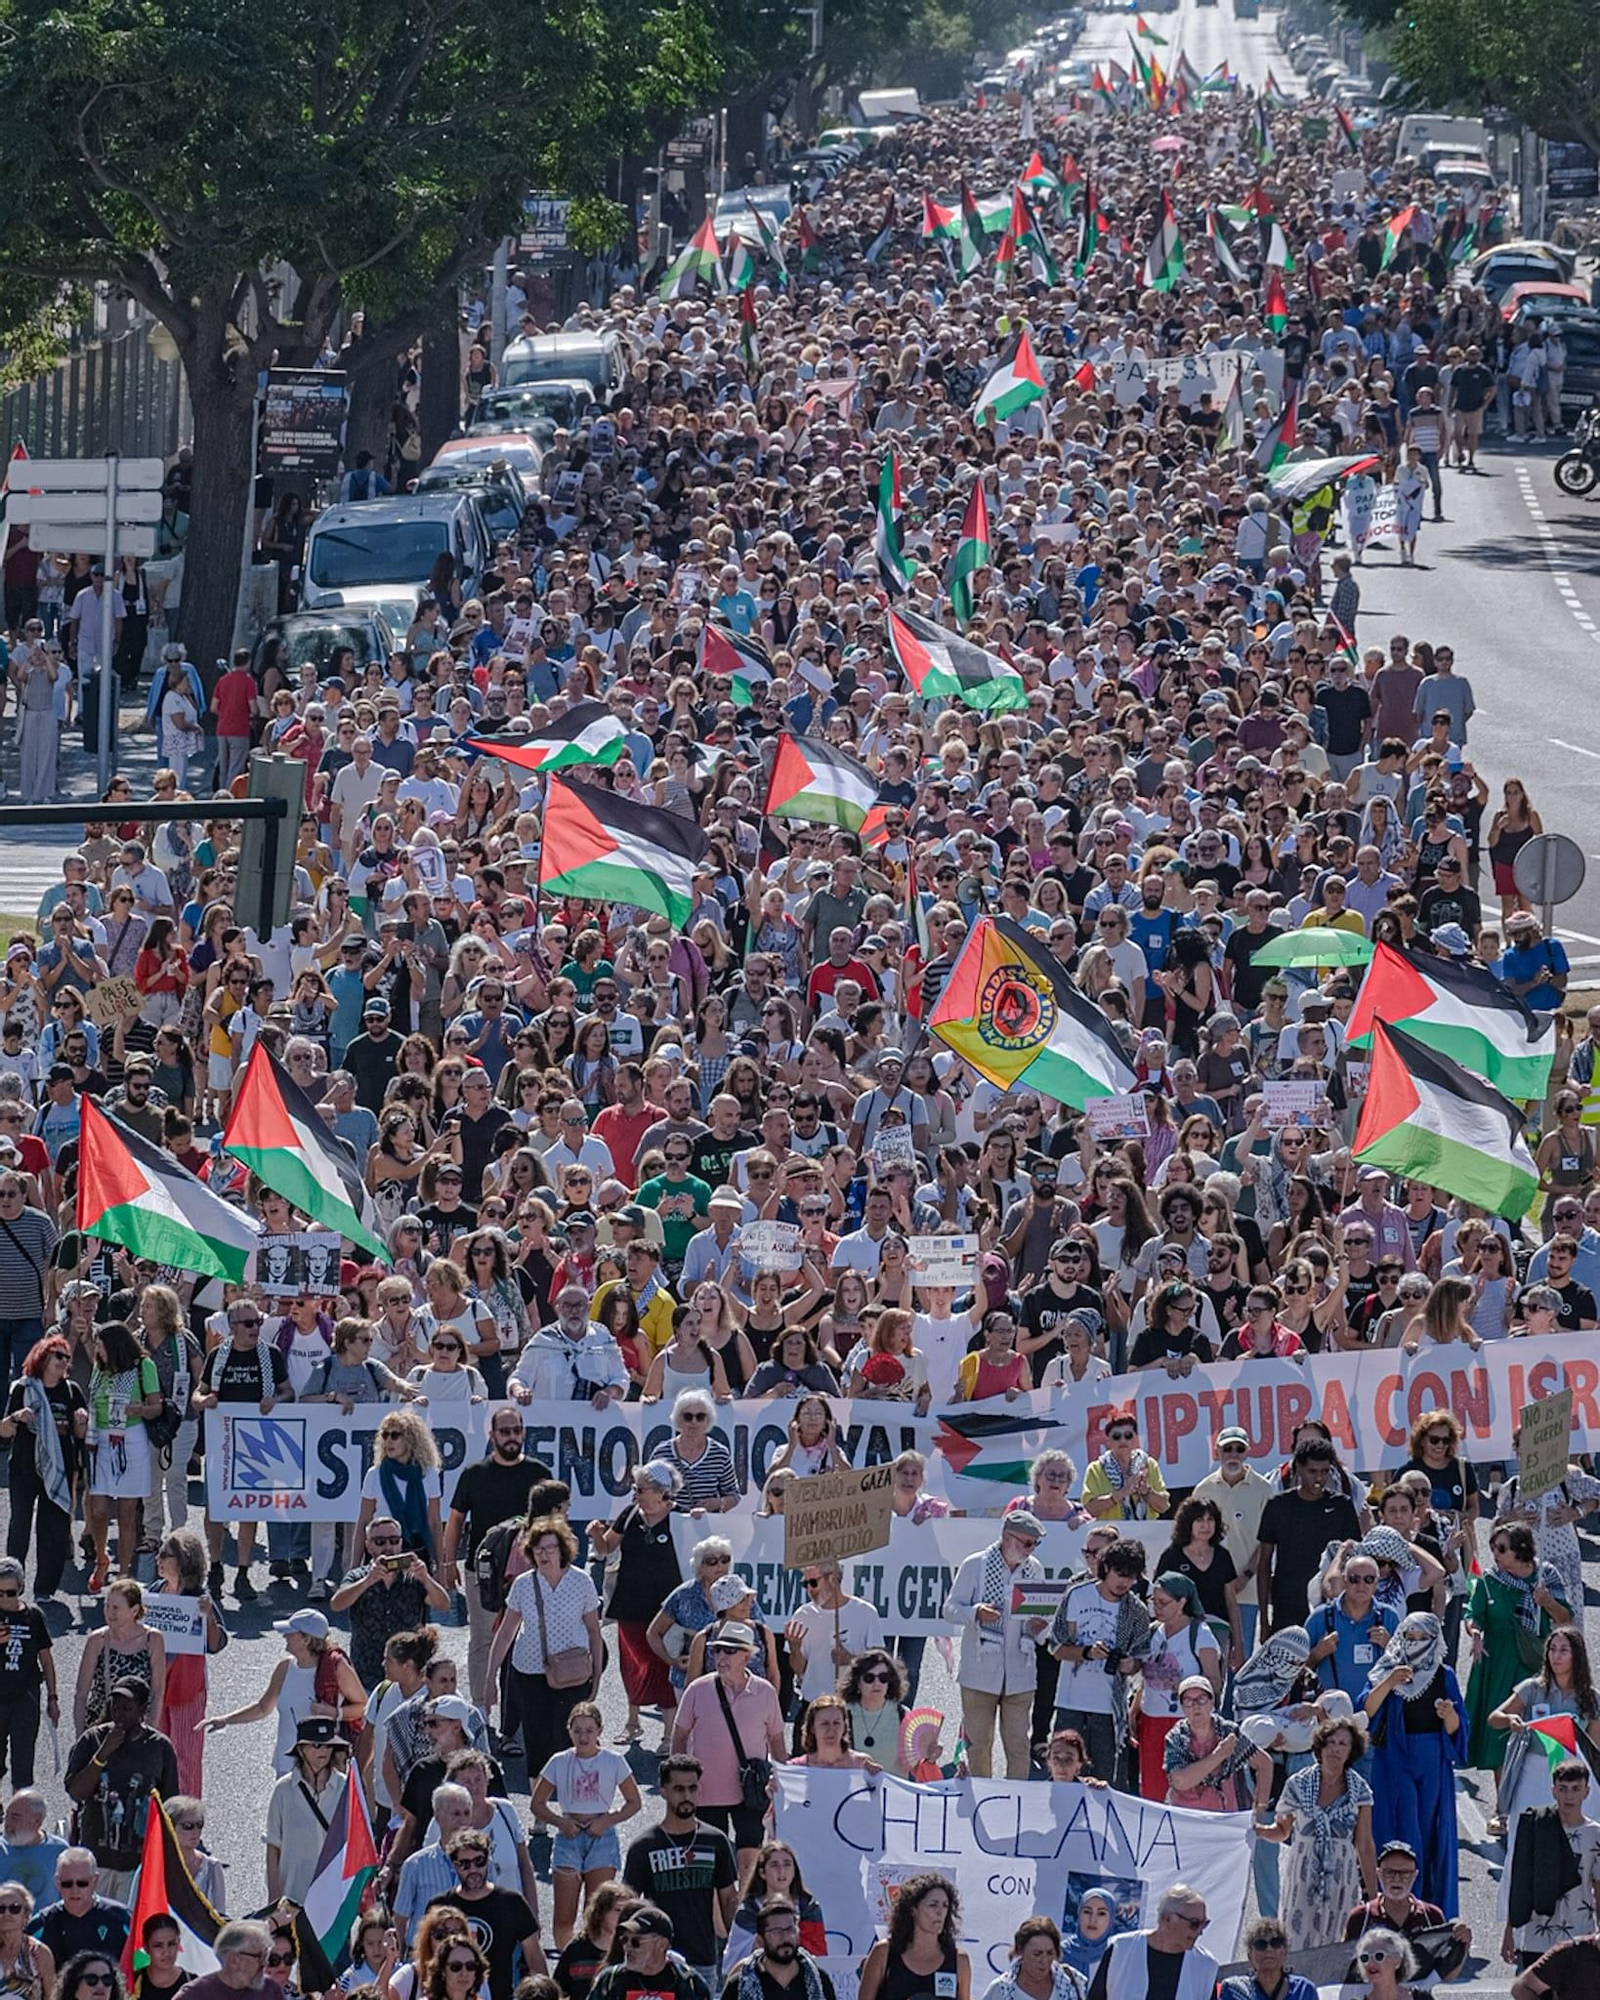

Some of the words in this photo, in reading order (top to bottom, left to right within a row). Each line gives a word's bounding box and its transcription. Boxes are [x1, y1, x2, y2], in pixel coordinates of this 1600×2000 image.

[1374, 1366, 1492, 1448] CON
[1524, 1405, 1541, 1429] NO
[1533, 1420, 1564, 1445] GUERRA
[221, 1416, 231, 1491] www.apdha.org
[316, 1428, 467, 1500] STP
[1526, 1451, 1540, 1470] ES
[227, 1493, 307, 1509] APDHA
[788, 1478, 844, 1504] VERANO
[860, 1468, 893, 1493] GAZA
[789, 1502, 868, 1538] HAMBRUNA
[796, 1527, 874, 1564] GENOCIDIO
[852, 1564, 889, 1619] EL
[833, 1786, 1181, 1870] CHICLANA
[648, 1846, 685, 1874] FREE
[987, 1874, 1031, 1896] CON
